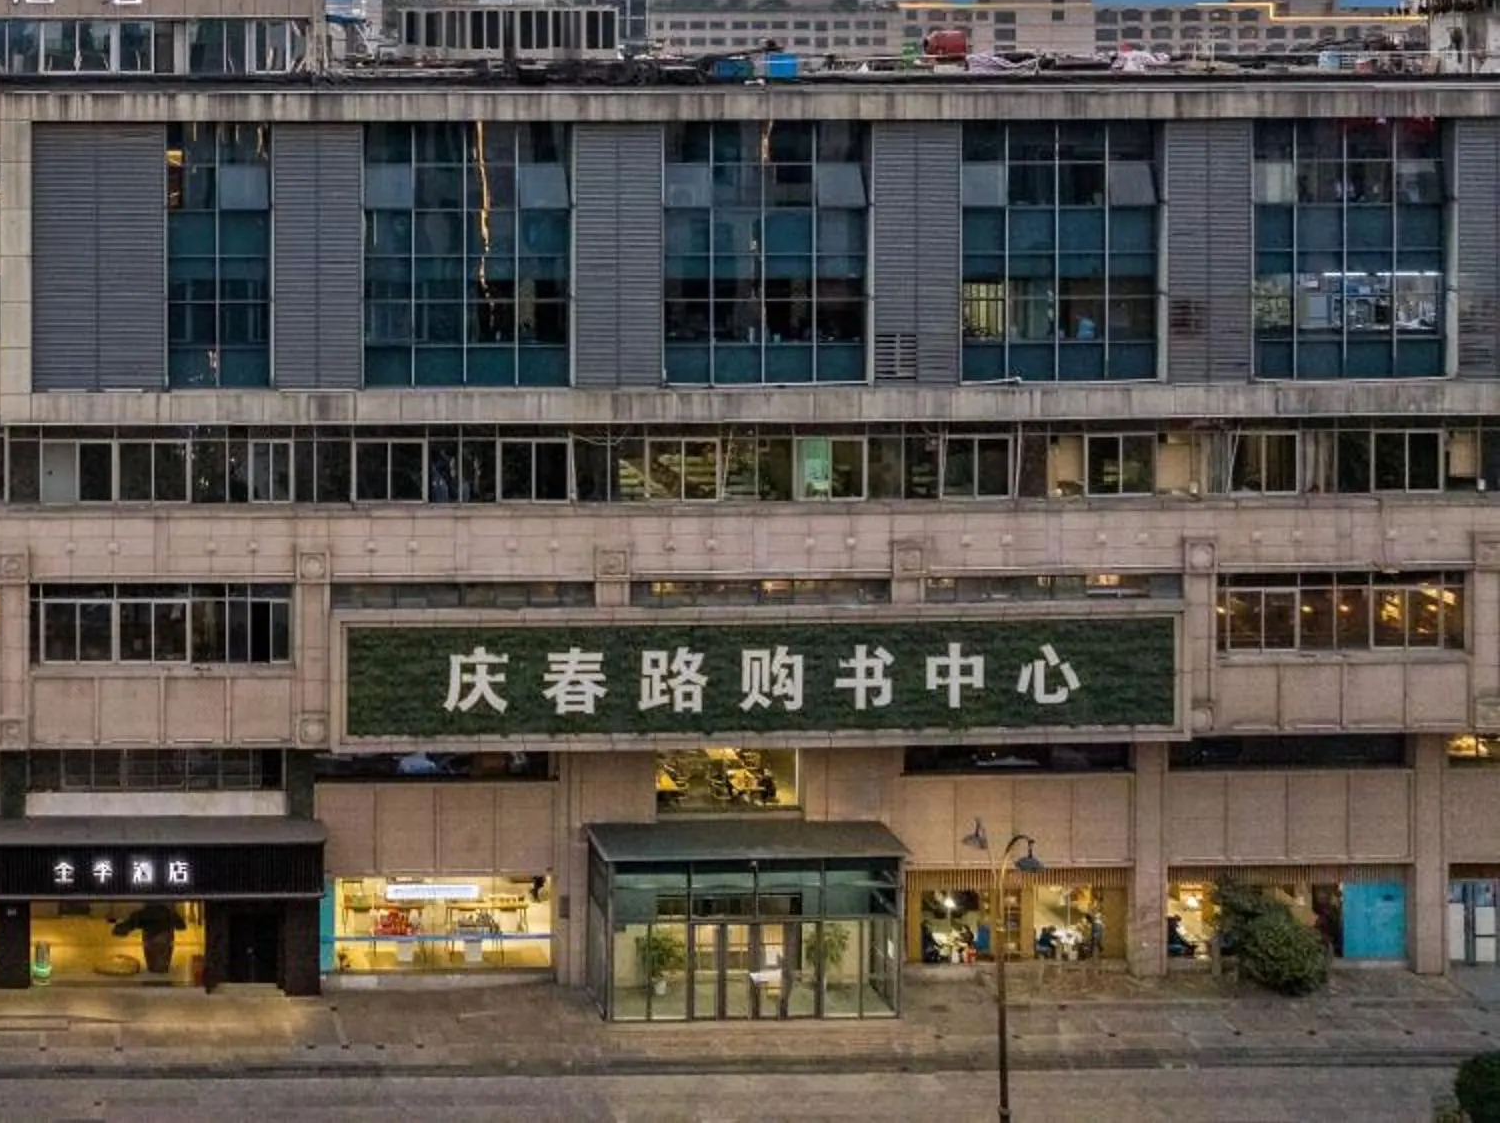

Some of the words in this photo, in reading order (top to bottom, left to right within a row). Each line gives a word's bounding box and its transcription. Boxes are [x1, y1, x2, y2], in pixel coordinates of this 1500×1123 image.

[443, 643, 1081, 715] 庆春路购书中心
[53, 860, 190, 885] 全季酒店
